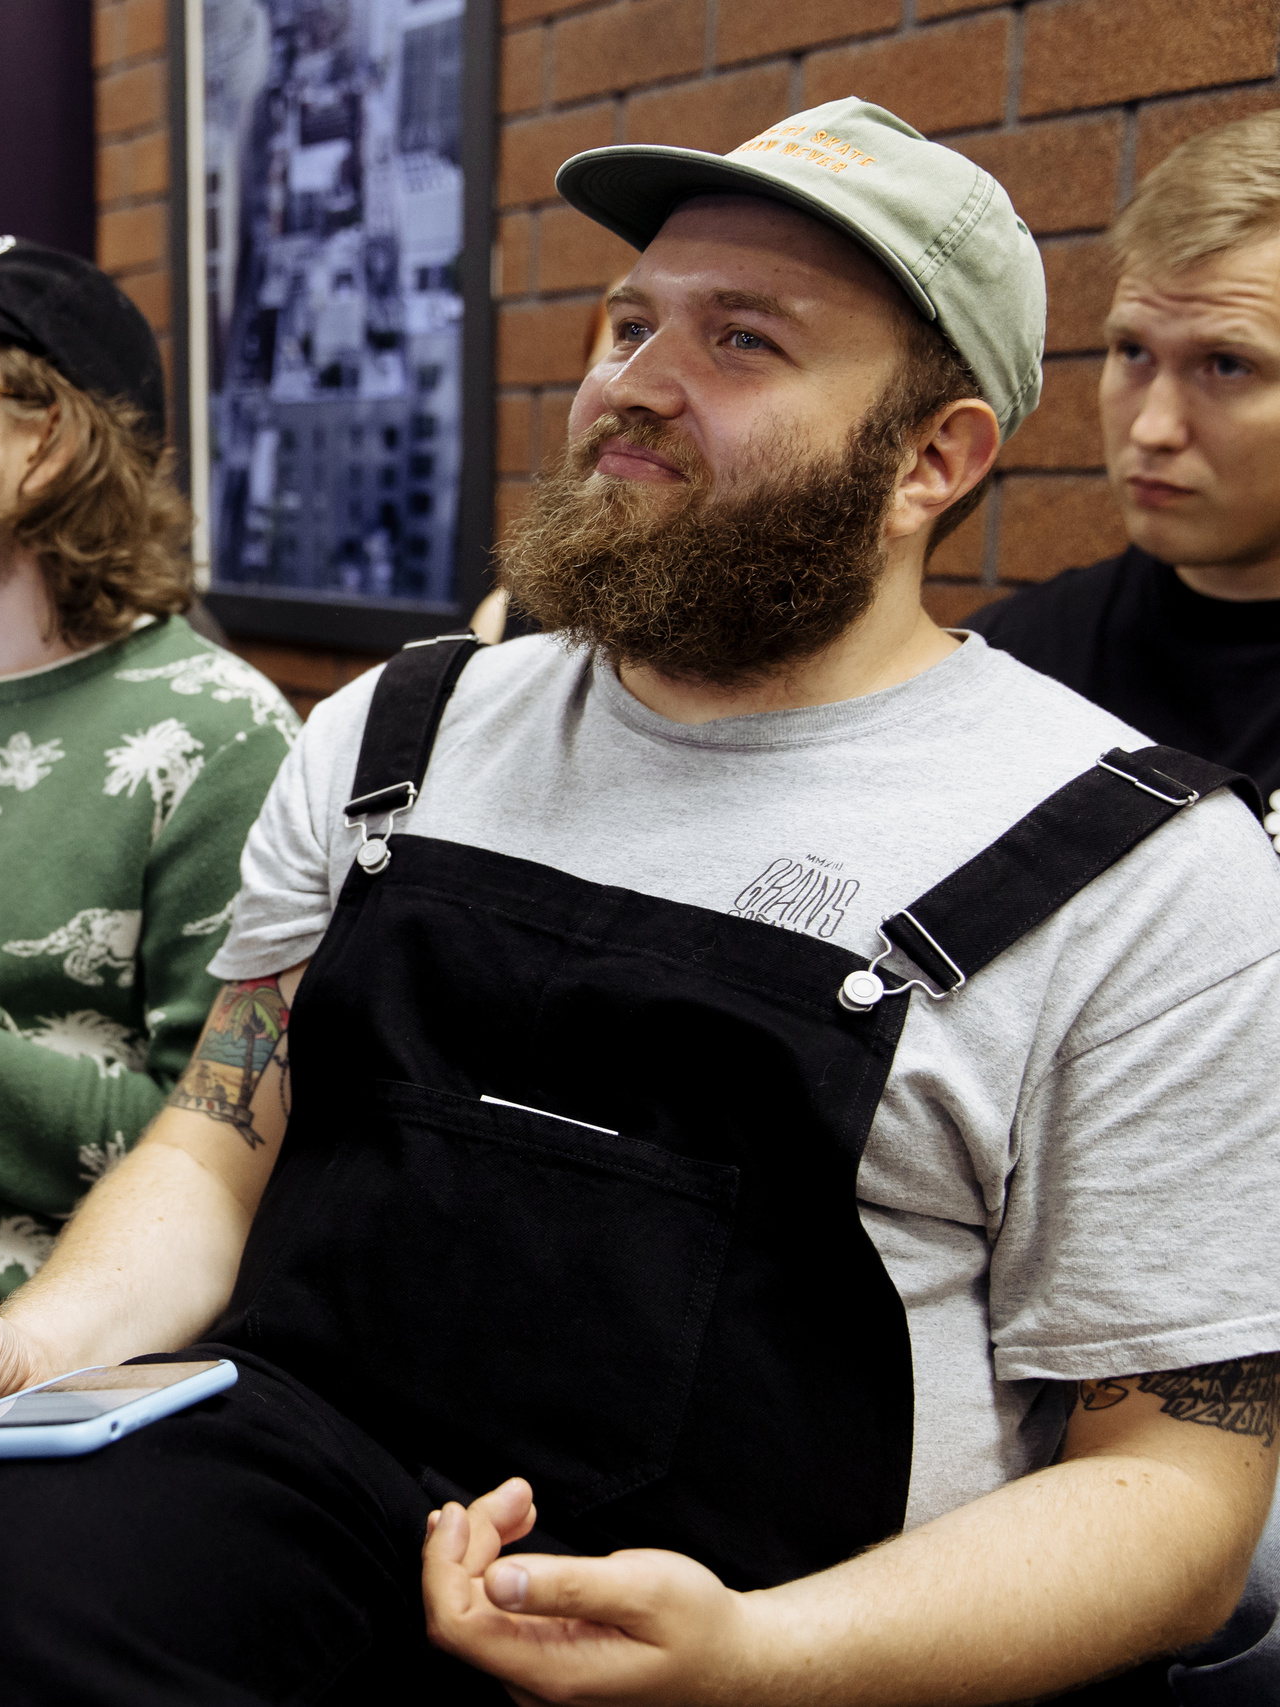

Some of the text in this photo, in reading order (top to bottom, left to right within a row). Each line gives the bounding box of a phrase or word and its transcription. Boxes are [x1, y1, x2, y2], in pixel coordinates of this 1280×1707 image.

[780, 142, 849, 173] NEVER
[810, 129, 878, 167] SKATE
[734, 858, 861, 938] GRAINS
